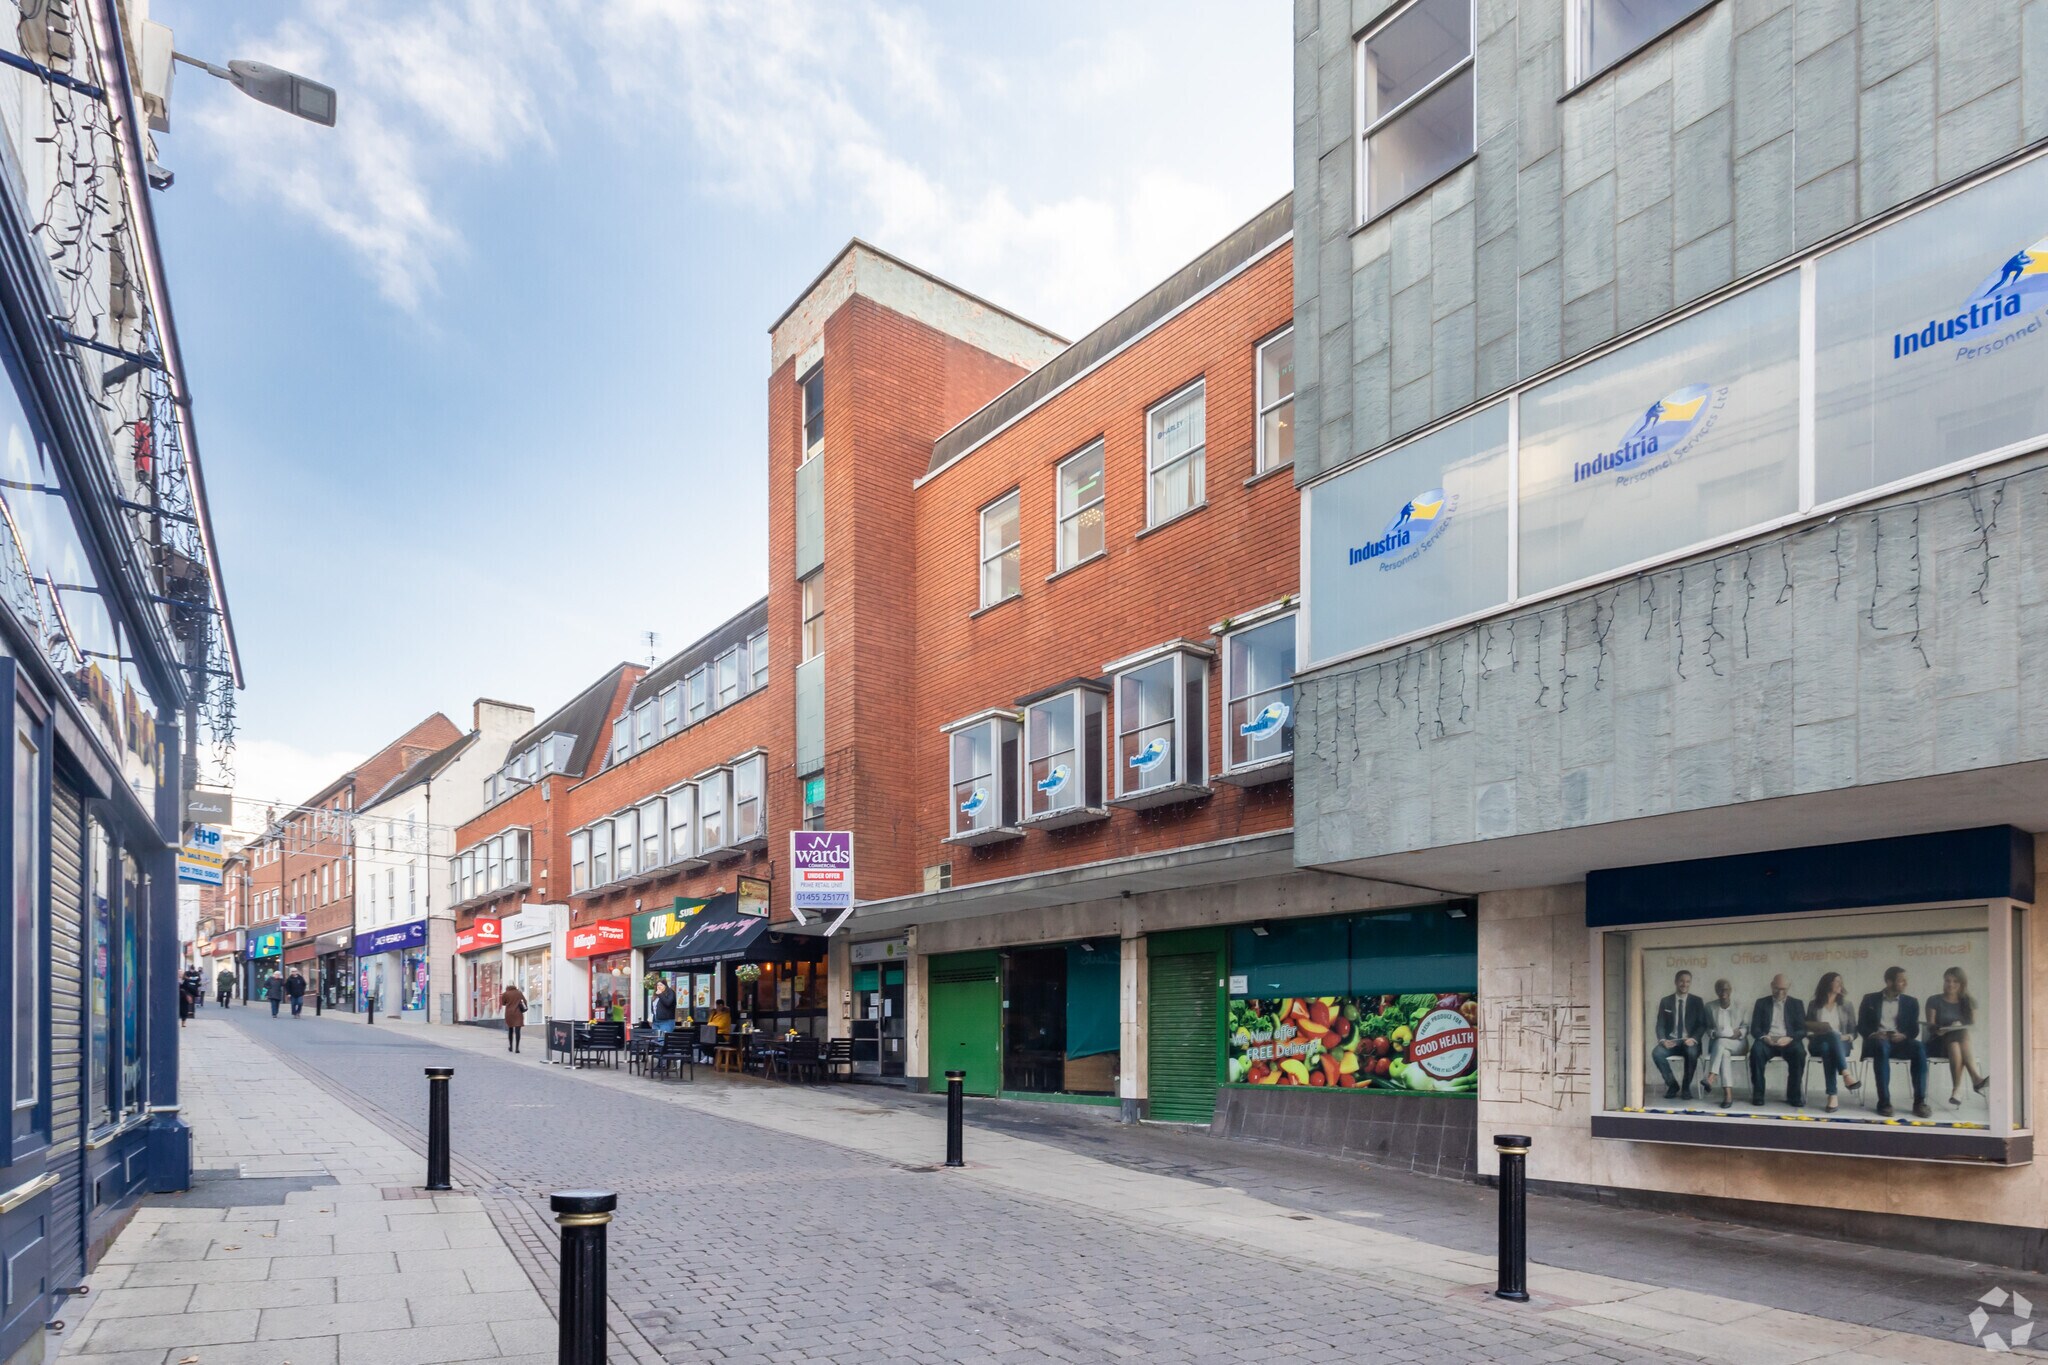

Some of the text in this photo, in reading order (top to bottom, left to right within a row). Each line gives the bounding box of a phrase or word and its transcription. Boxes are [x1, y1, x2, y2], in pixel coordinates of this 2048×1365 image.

[1894, 293, 2021, 359] Industria
[1955, 315, 2042, 361] Personnel
[1615, 386, 1729, 488] Personnel Services Ltd
[1574, 435, 1658, 483] Industria
[1379, 494, 1459, 572] Personnel Services Ltd
[1349, 529, 1410, 566] Industria
[795, 845, 850, 863] wards
[807, 872, 825, 880] UNDER
[797, 893, 850, 901] 01455 251771
[1731, 952, 1768, 965] Office
[1789, 947, 1869, 962] Warehouse
[1897, 941, 1972, 958] Technical
[1666, 955, 1708, 969] Driving
[1250, 1029, 1272, 1044] Now
[1274, 1024, 1298, 1042] offer
[1421, 1013, 1463, 1035] FRESH PRODUCE FOR
[1246, 1044, 1274, 1060] FREE
[1415, 1031, 1475, 1057] GOOD HEALTH
